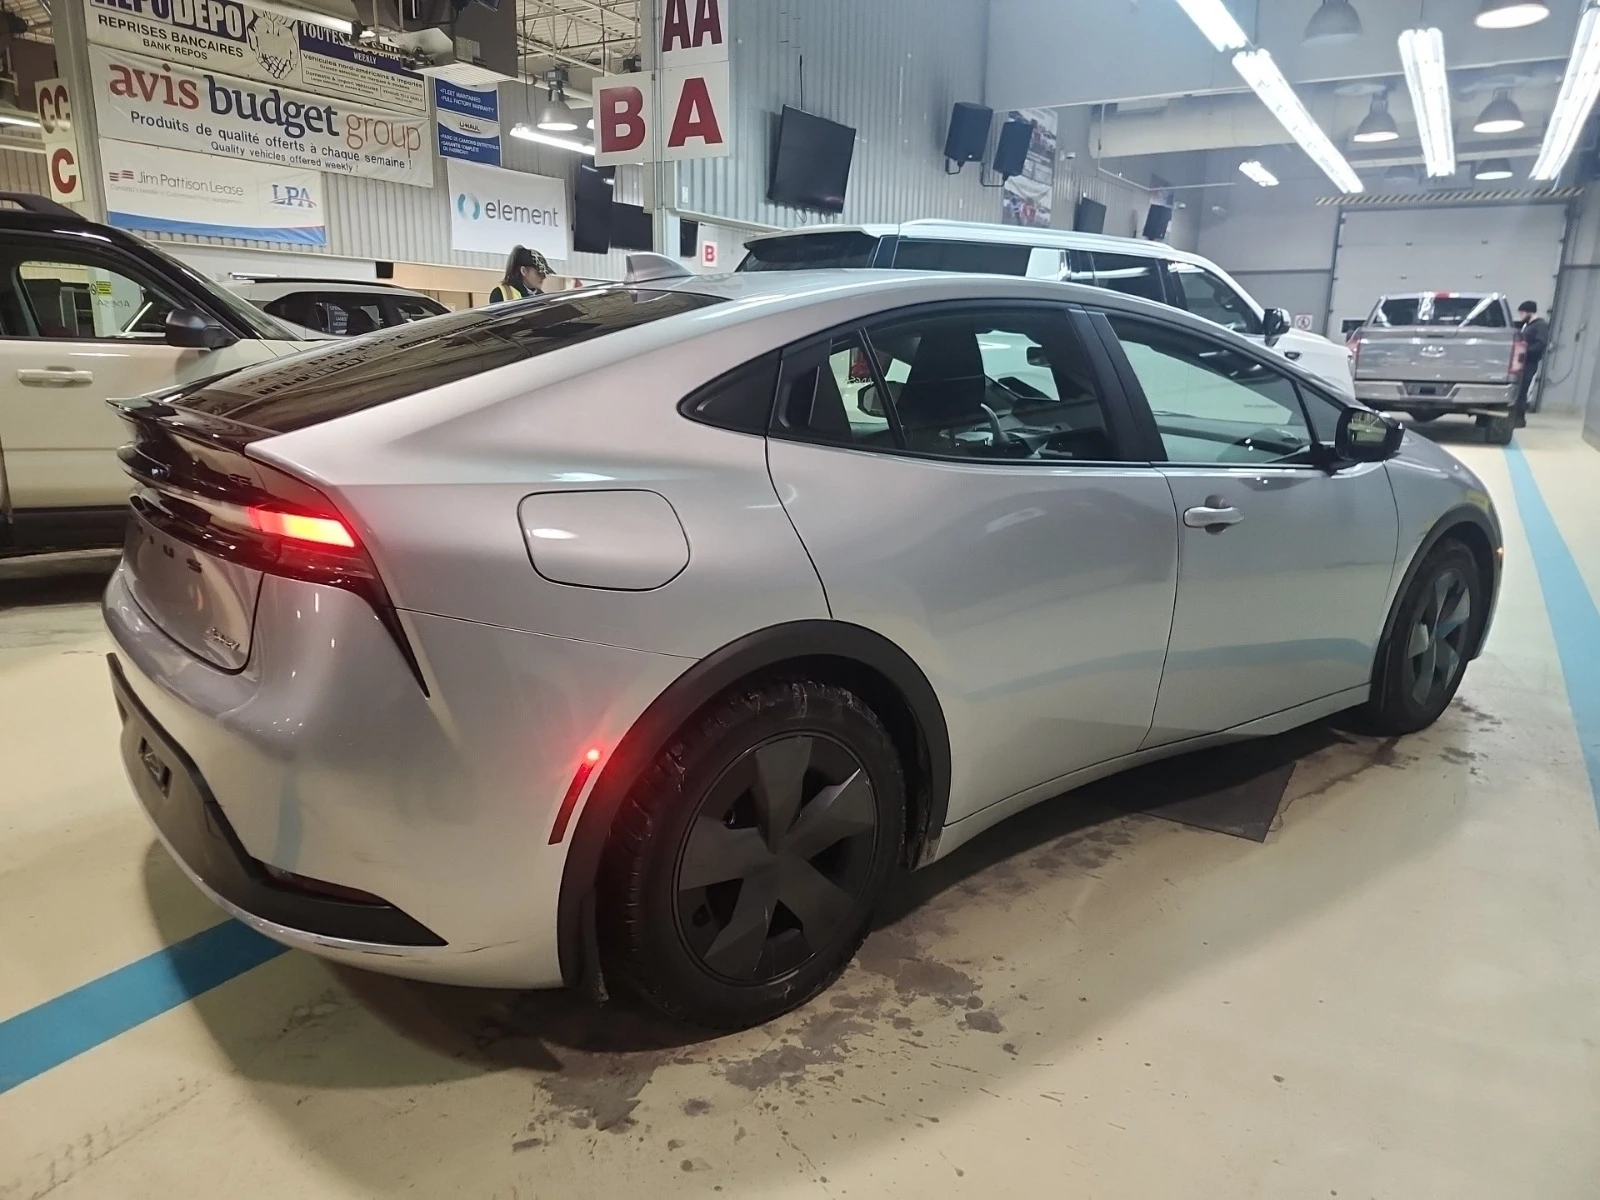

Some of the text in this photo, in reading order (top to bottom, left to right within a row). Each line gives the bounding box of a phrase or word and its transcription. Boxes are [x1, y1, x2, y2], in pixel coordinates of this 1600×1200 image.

[98, 14, 244, 58] REPRISES BANCAIRES
[662, 0, 722, 52] AA
[143, 38, 208, 60] BANK REPOS
[39, 85, 71, 134] CC
[109, 63, 421, 158] avis budget group
[600, 86, 646, 153] B
[668, 77, 723, 148] A
[131, 110, 189, 133] Produits
[196, 123, 212, 136] de
[218, 130, 260, 145] qualité
[265, 137, 305, 152] offerts
[310, 142, 317, 154] à
[321, 146, 360, 163] chaque
[364, 153, 405, 169] semaine
[211, 141, 245, 157] Quality
[250, 149, 286, 162] vehicles
[289, 153, 322, 167] offered
[324, 161, 353, 173] weekly
[51, 148, 76, 194] C
[137, 171, 244, 196] Jim Pattison Lease
[272, 184, 314, 209] LPA
[485, 199, 559, 227] element
[704, 244, 715, 262] B
